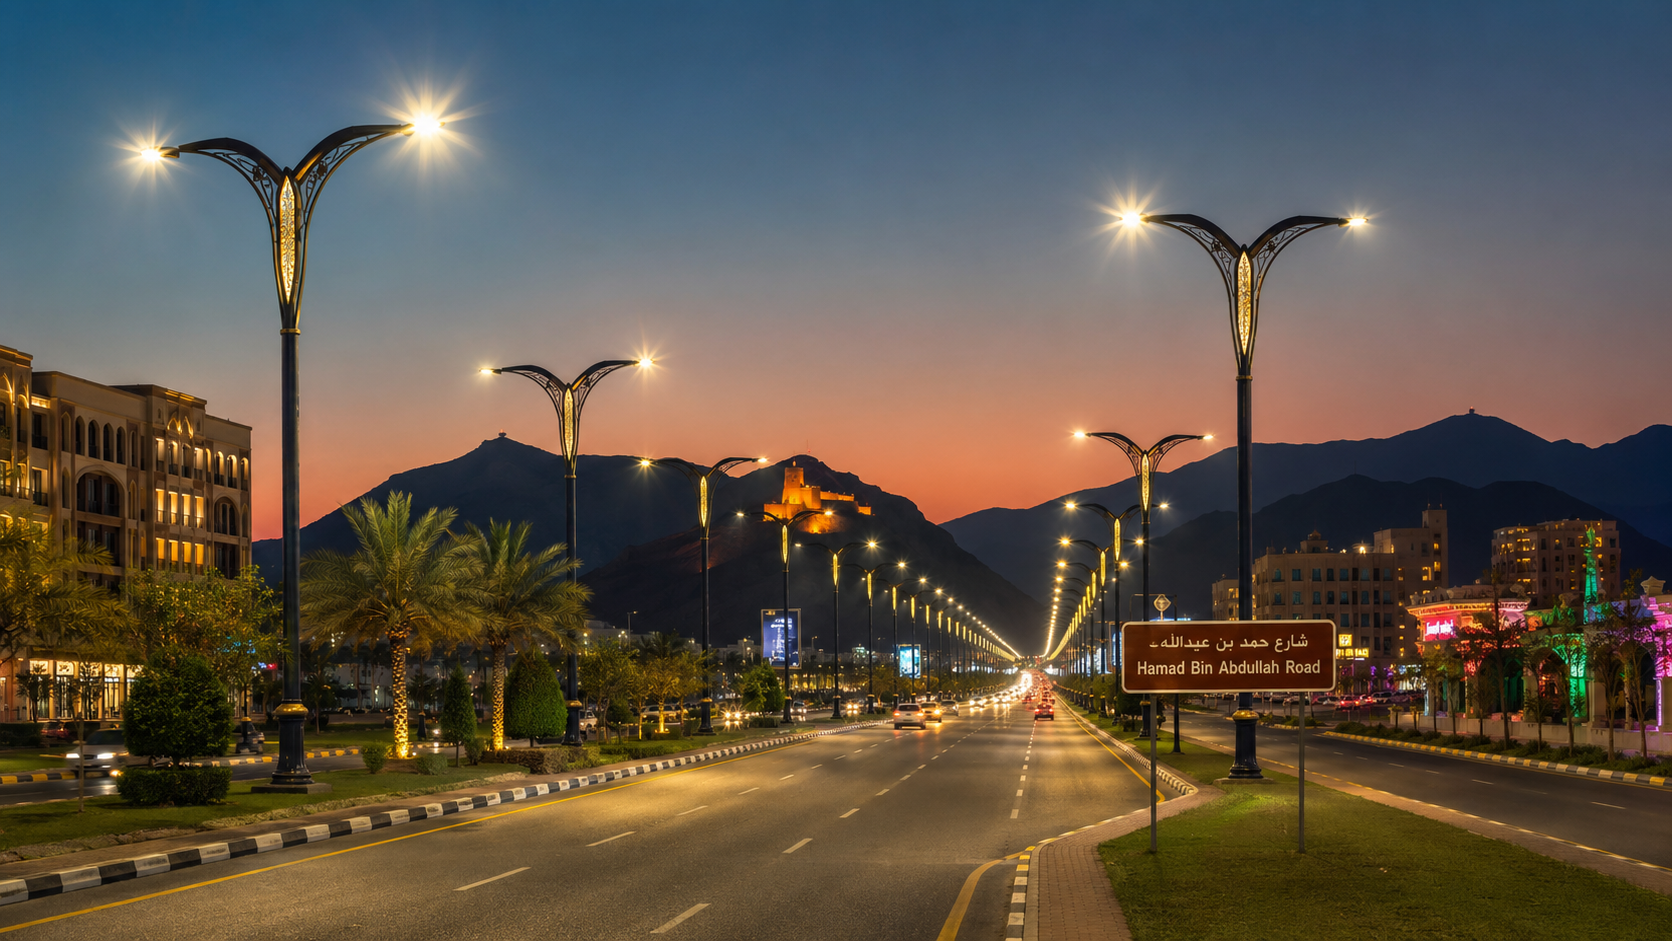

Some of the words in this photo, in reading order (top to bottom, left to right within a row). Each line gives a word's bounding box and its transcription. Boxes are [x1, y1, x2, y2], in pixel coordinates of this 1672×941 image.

[1216, 637, 1234, 652] بن
[1239, 638, 1269, 649] حمد
[1274, 633, 1308, 653] شارع
[1137, 660, 1185, 675] Hamad
[1191, 660, 1213, 675] Bin
[1218, 659, 1280, 675] Abdullah
[1285, 659, 1321, 674] Road
